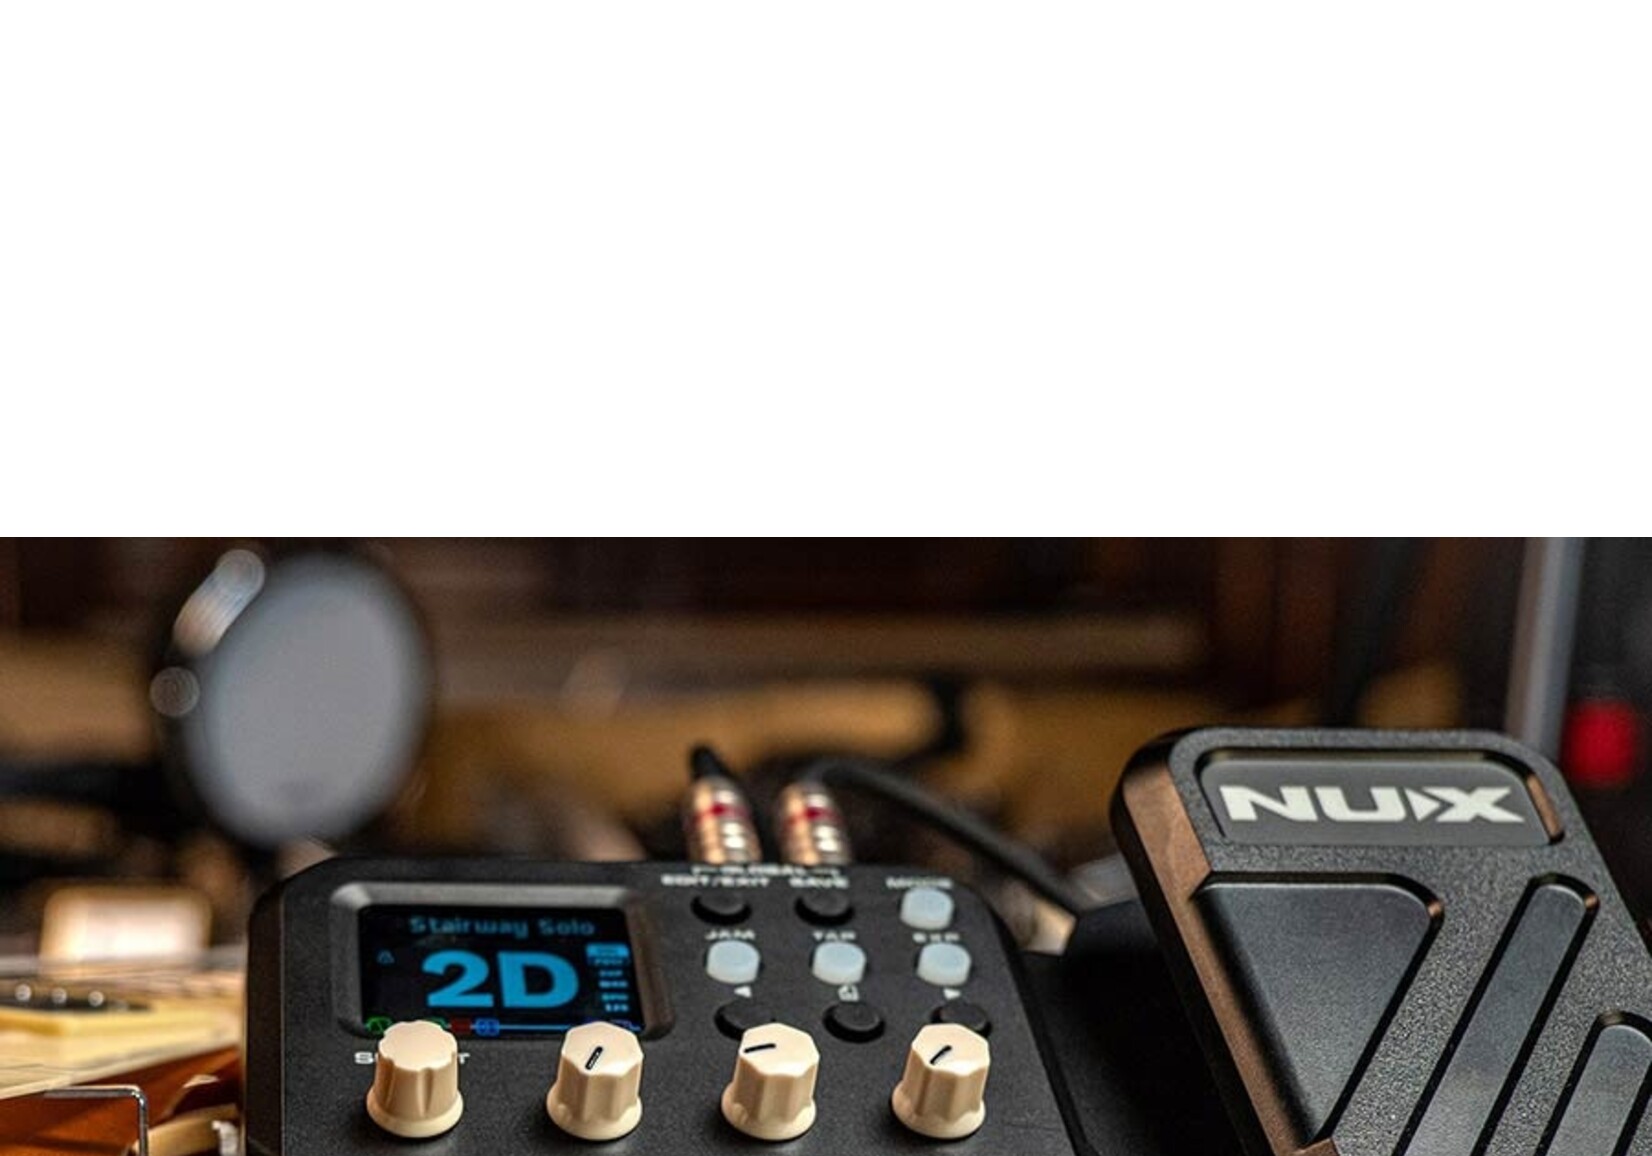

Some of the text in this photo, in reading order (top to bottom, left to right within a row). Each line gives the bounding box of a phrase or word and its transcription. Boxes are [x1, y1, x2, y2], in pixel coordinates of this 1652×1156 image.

[1219, 785, 1525, 823] NUX
[409, 917, 597, 938] Stairway Solo
[705, 929, 756, 941] JAM
[421, 949, 580, 1008] 2D
